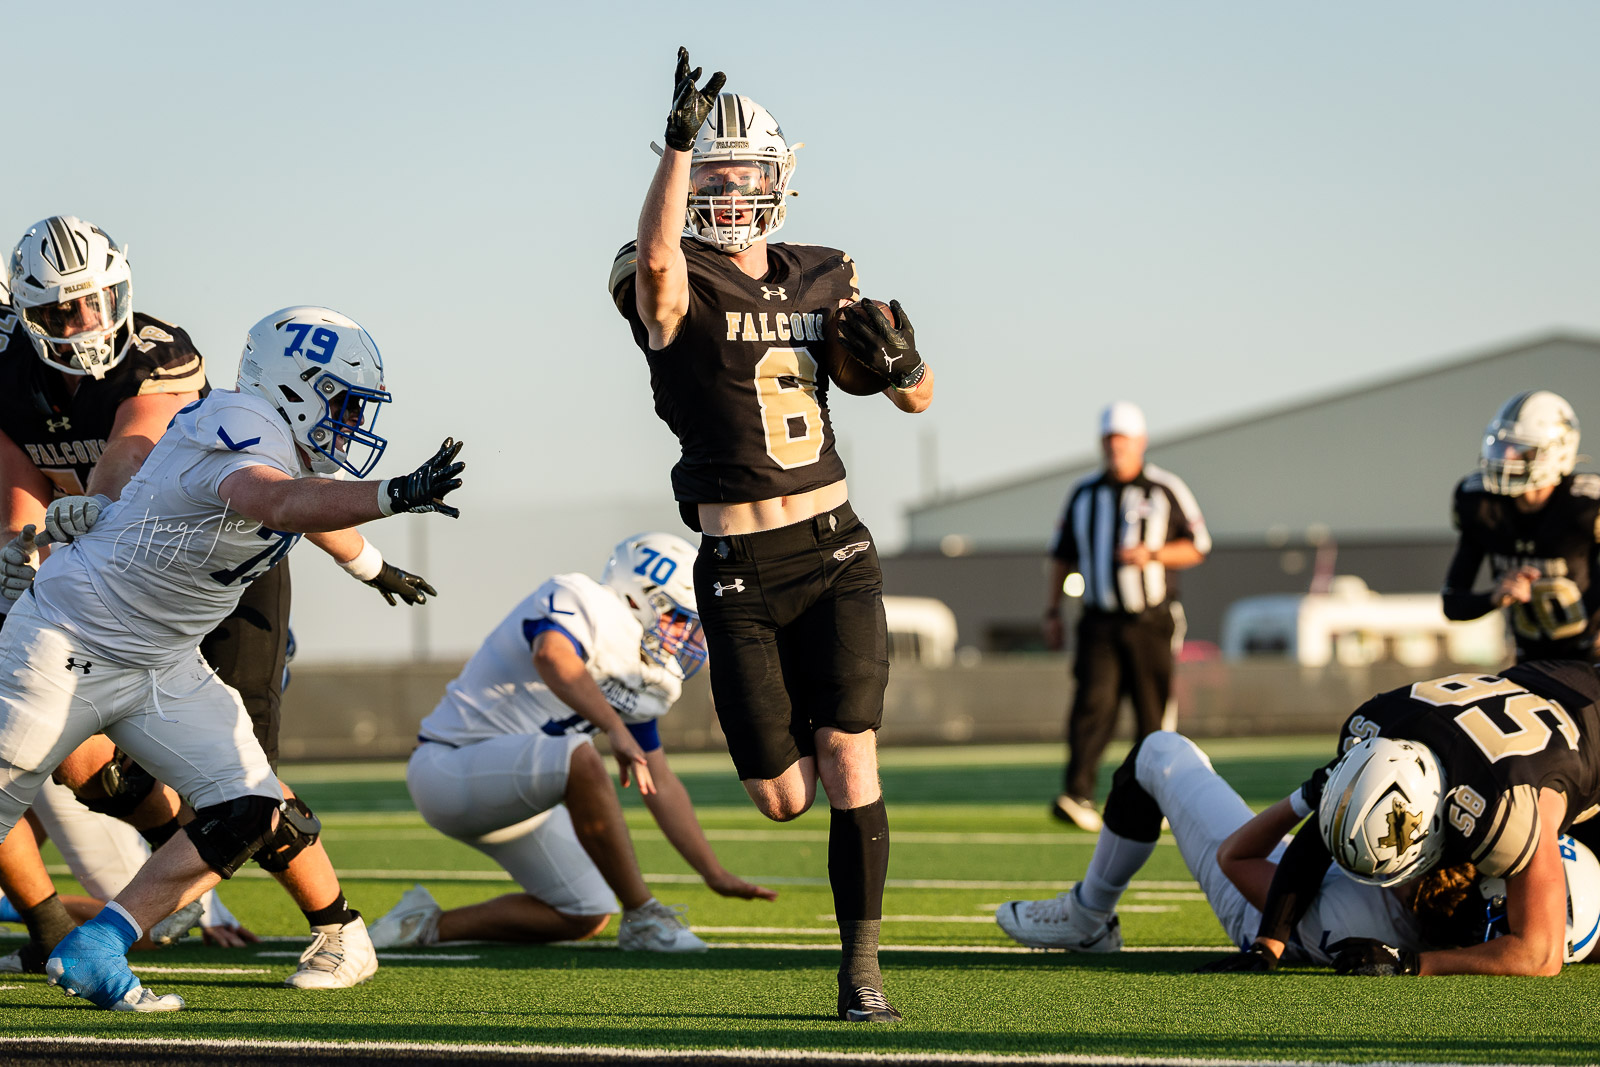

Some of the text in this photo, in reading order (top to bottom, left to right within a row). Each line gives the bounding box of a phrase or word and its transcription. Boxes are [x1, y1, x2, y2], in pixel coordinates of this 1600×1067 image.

[715, 141, 750, 150] FALCONS
[284, 323, 340, 365] 79
[754, 346, 825, 471] 6
[634, 547, 677, 586] 70
[1410, 672, 1581, 764] 58
[1448, 785, 1487, 838] 58
